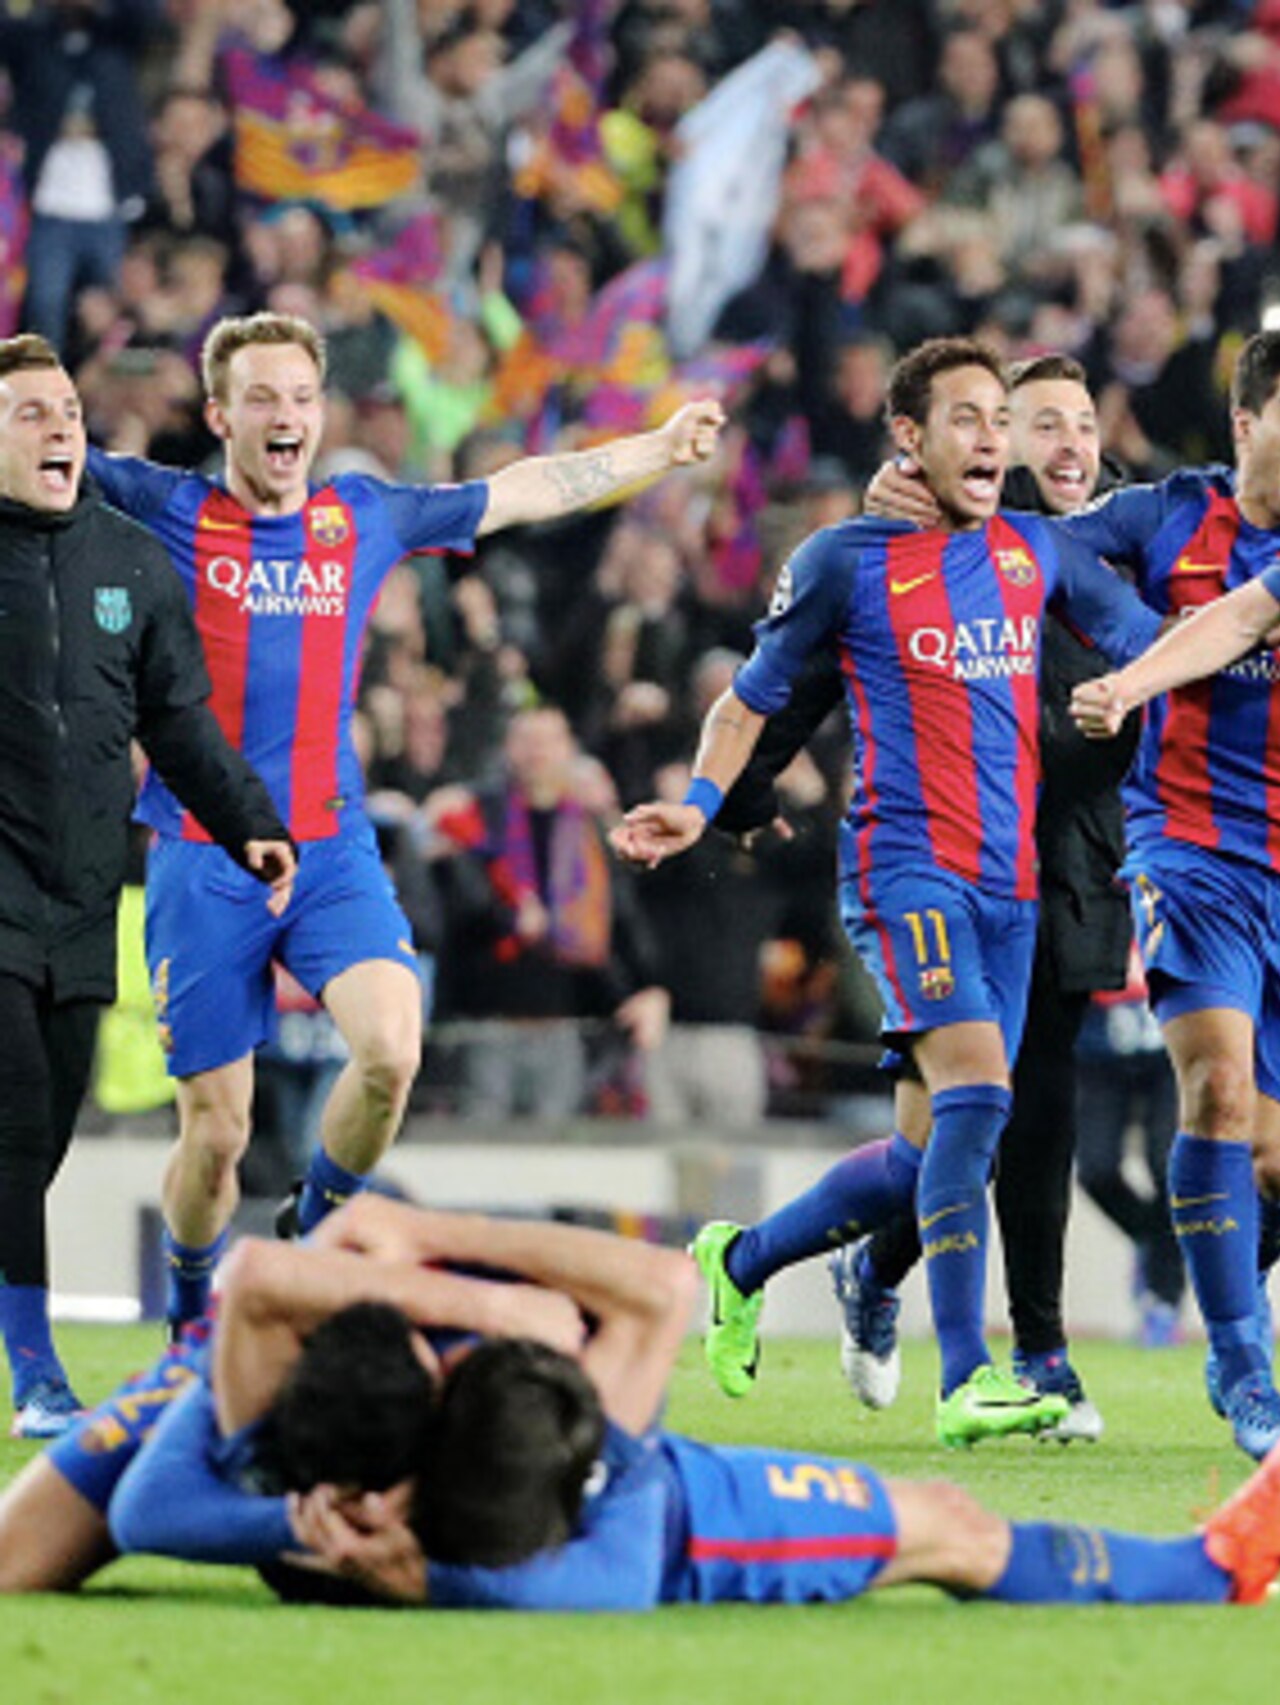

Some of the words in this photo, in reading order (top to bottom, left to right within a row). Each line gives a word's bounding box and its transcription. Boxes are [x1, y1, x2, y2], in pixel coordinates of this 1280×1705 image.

[206, 555, 345, 598] QATAR
[239, 594, 345, 616] AIRWAYS
[908, 615, 1036, 669] QATAR
[903, 908, 951, 965] 11
[767, 1464, 840, 1503] 5
